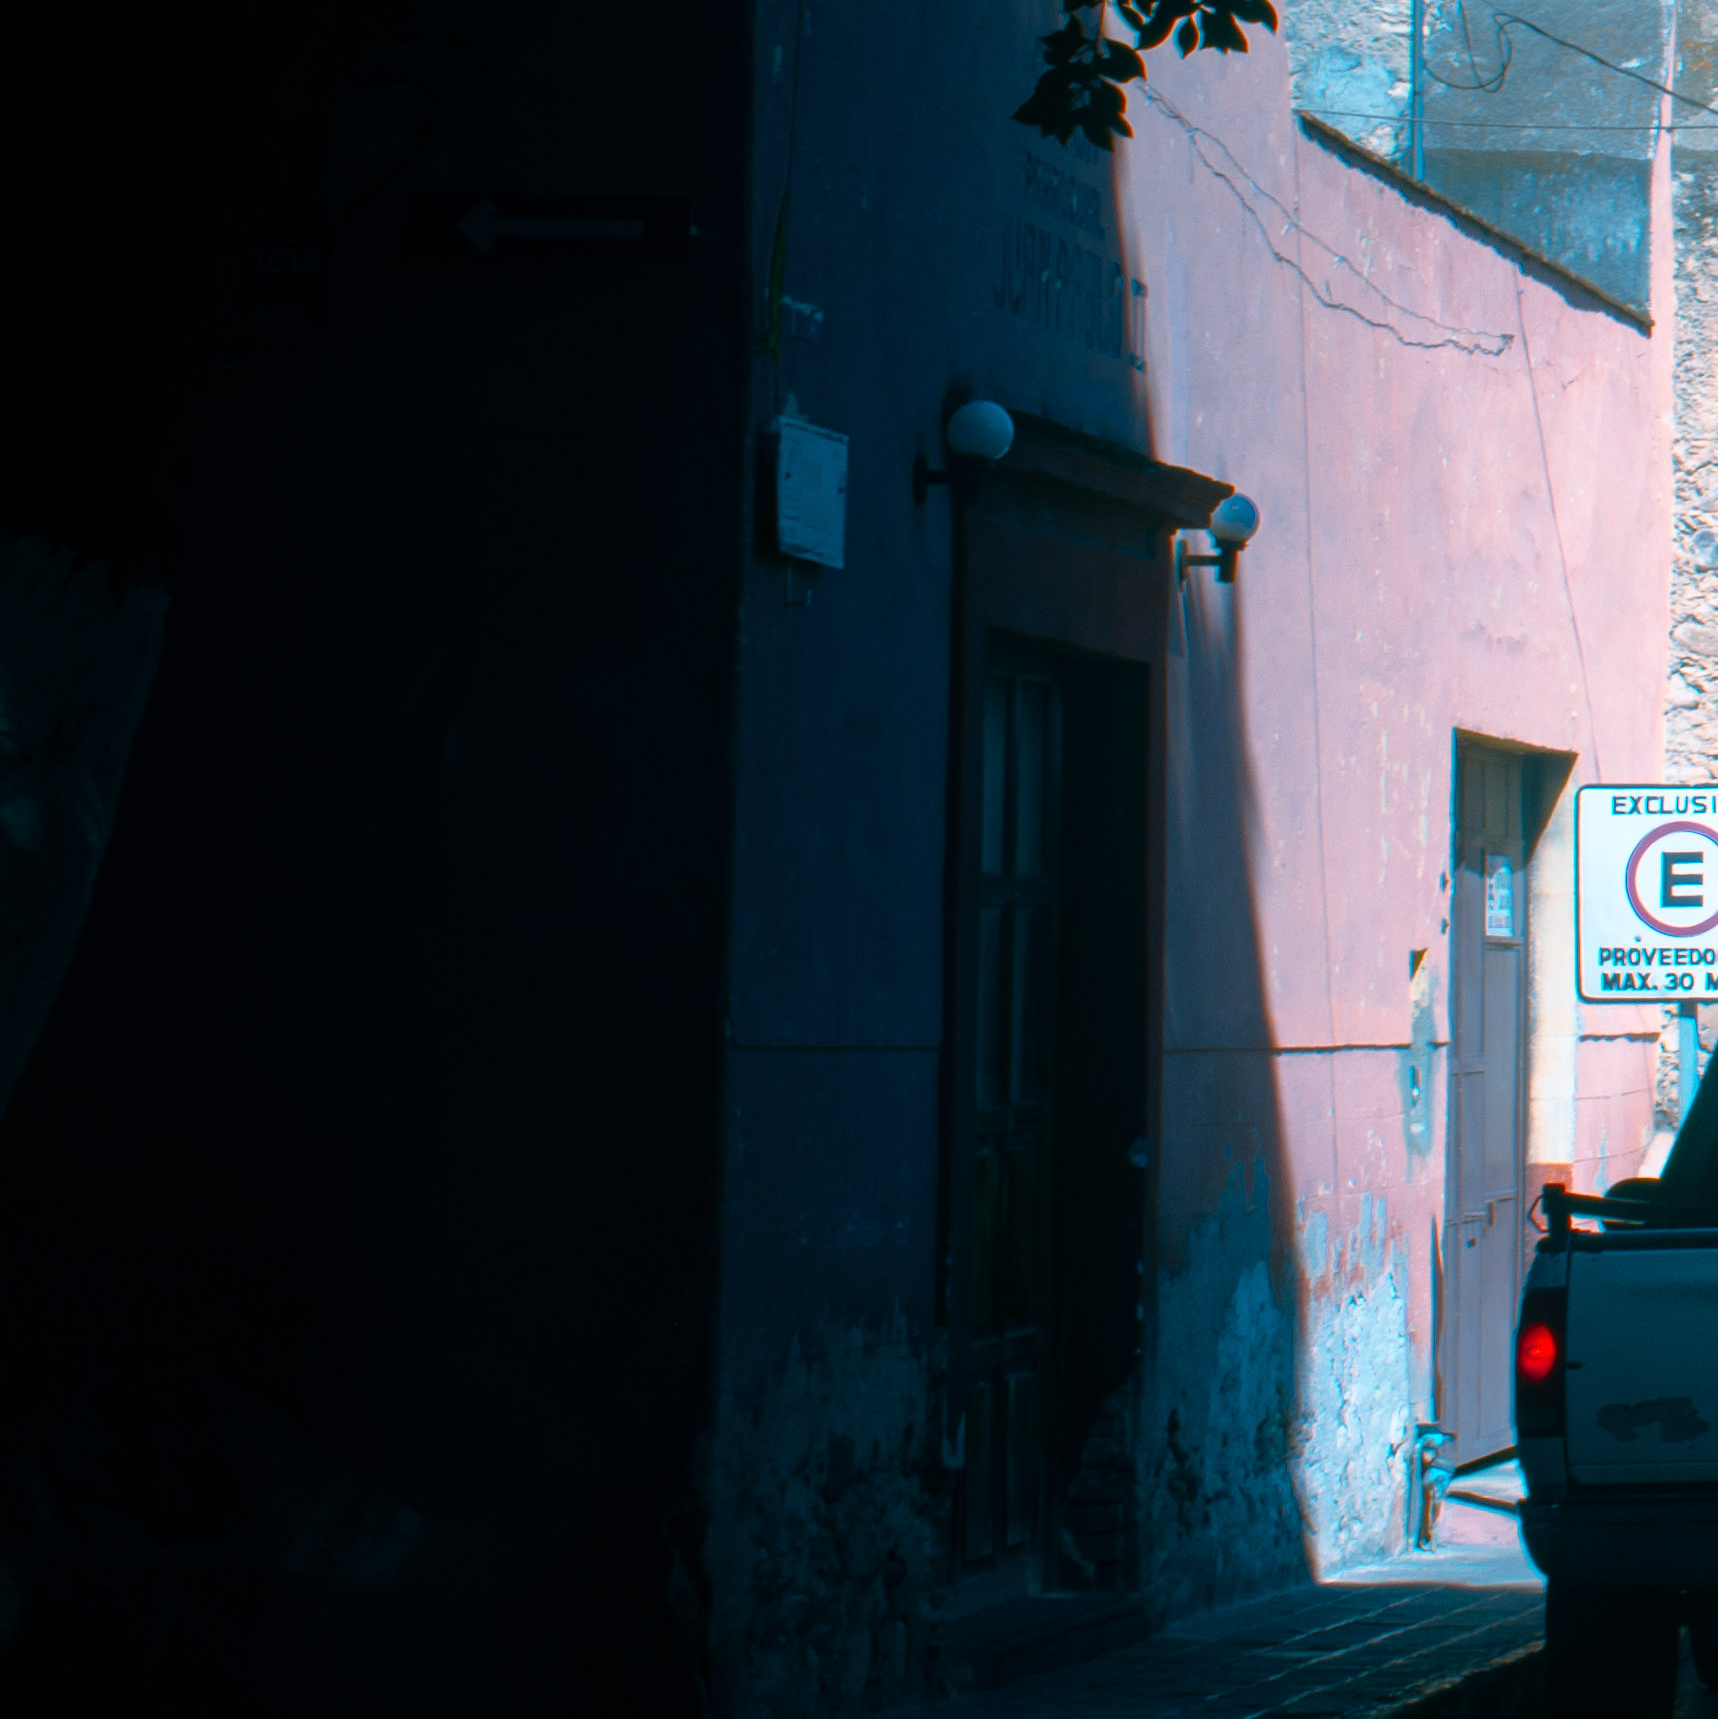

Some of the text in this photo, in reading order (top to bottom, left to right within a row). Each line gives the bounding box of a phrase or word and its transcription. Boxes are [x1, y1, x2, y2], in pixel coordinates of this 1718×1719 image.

[1660, 851, 1704, 908] E
[1600, 972, 1658, 992] MAX.
[1664, 972, 1695, 991] 30
